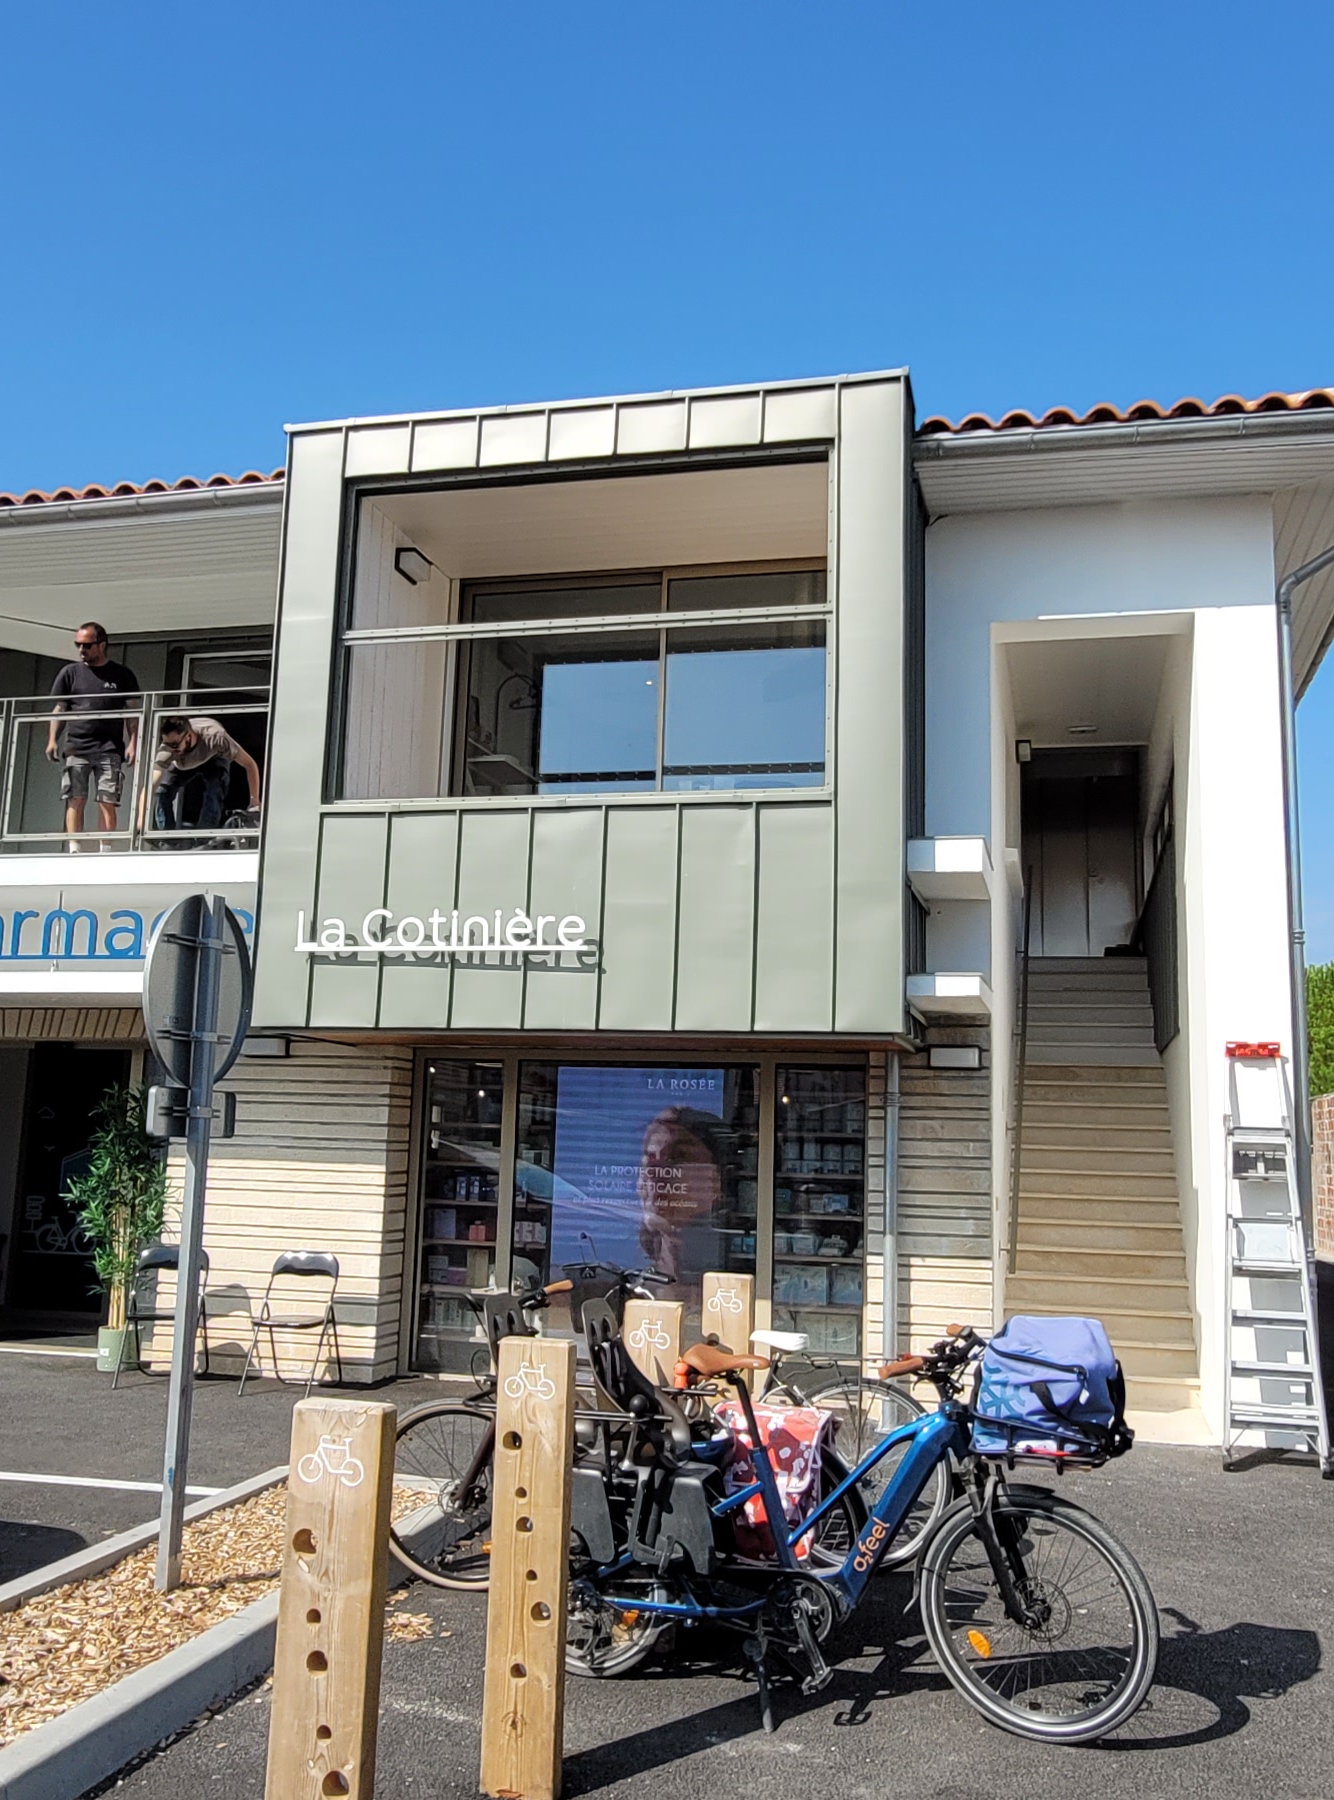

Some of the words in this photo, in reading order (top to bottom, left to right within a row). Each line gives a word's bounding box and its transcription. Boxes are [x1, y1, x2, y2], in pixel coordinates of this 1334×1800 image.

[296, 910, 347, 949] La
[361, 907, 587, 949] Cotinière
[647, 1078, 665, 1090] LA
[670, 1077, 716, 1091] ROSÉE
[594, 1164, 608, 1176] LA
[611, 1165, 682, 1179] PROTECTION
[587, 1179, 633, 1192] SOLAIRE
[636, 1181, 689, 1194] EFFICACE
